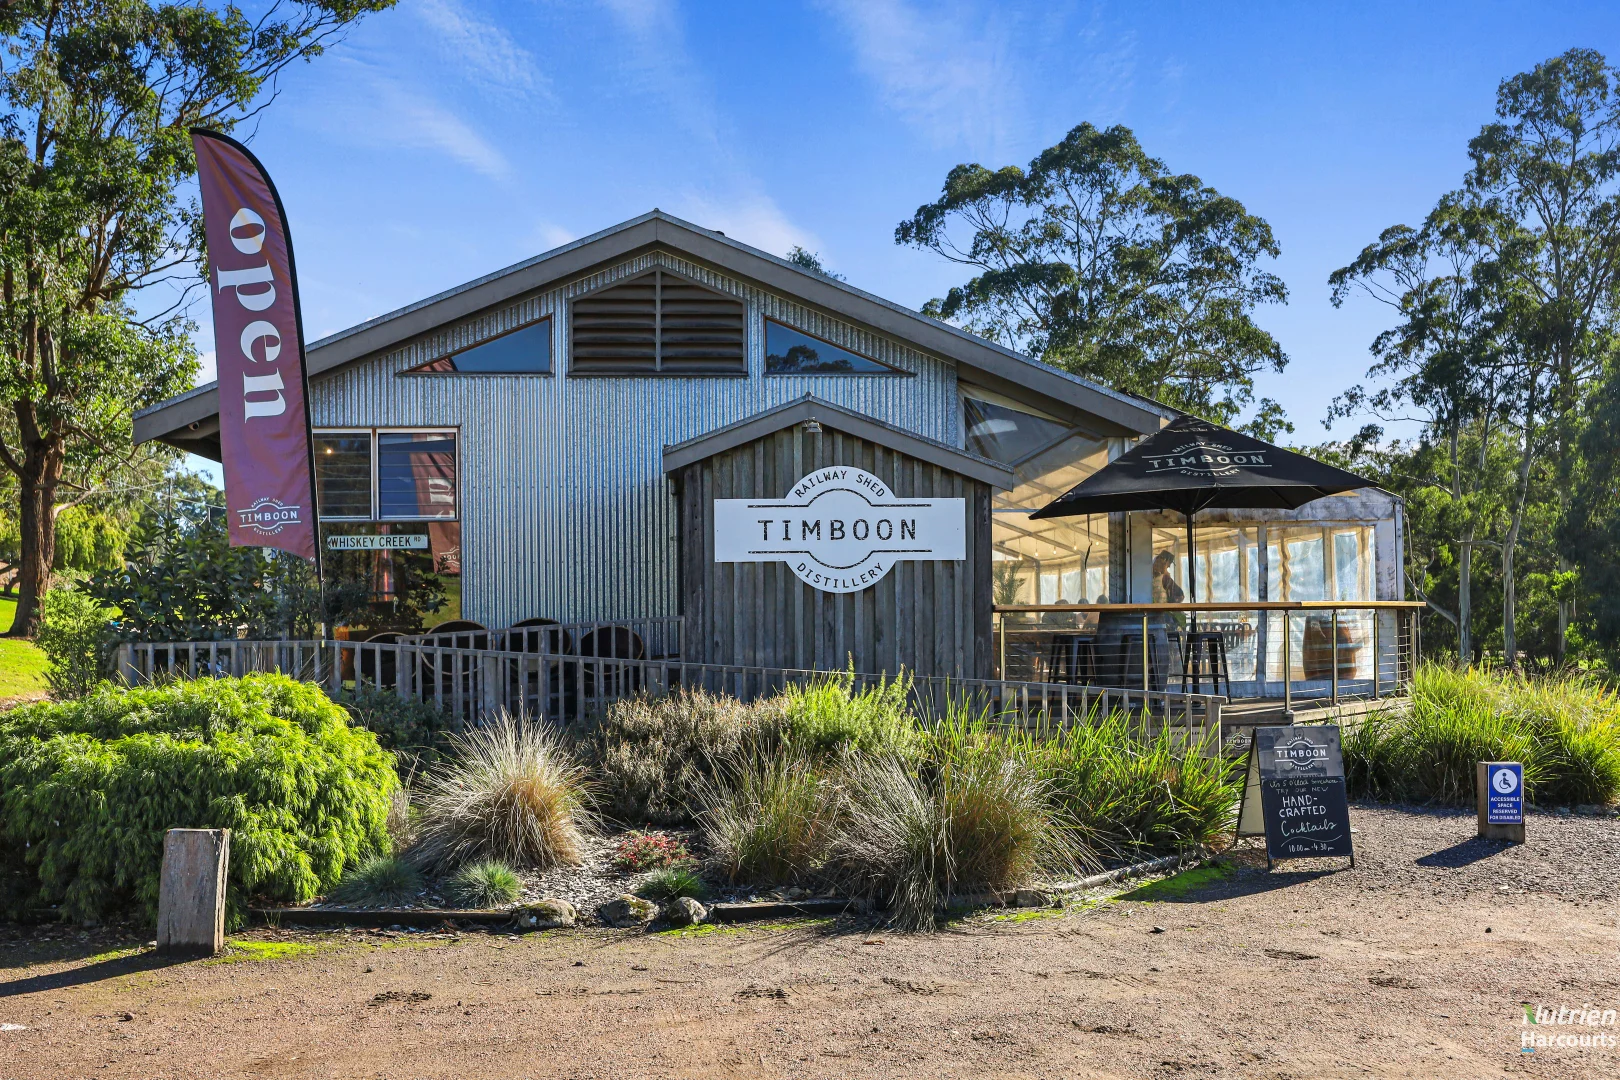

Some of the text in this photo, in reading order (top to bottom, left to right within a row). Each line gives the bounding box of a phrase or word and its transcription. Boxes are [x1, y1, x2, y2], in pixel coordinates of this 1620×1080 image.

[217, 207, 286, 424] open
[1149, 454, 1265, 469] TIMBOON
[794, 470, 886, 498] RAILWAY SHED
[240, 510, 298, 523] TIMBOON
[758, 518, 917, 541] TIMBOON
[330, 536, 375, 548] WHISKEY
[379, 536, 411, 547] CREEK
[796, 562, 883, 589] DISTILLERY
[1276, 749, 1327, 758] TIMBOON
[1282, 794, 1318, 808] HAND-
[1278, 805, 1327, 818] CRAFTED
[1281, 819, 1338, 837] Cocktails
